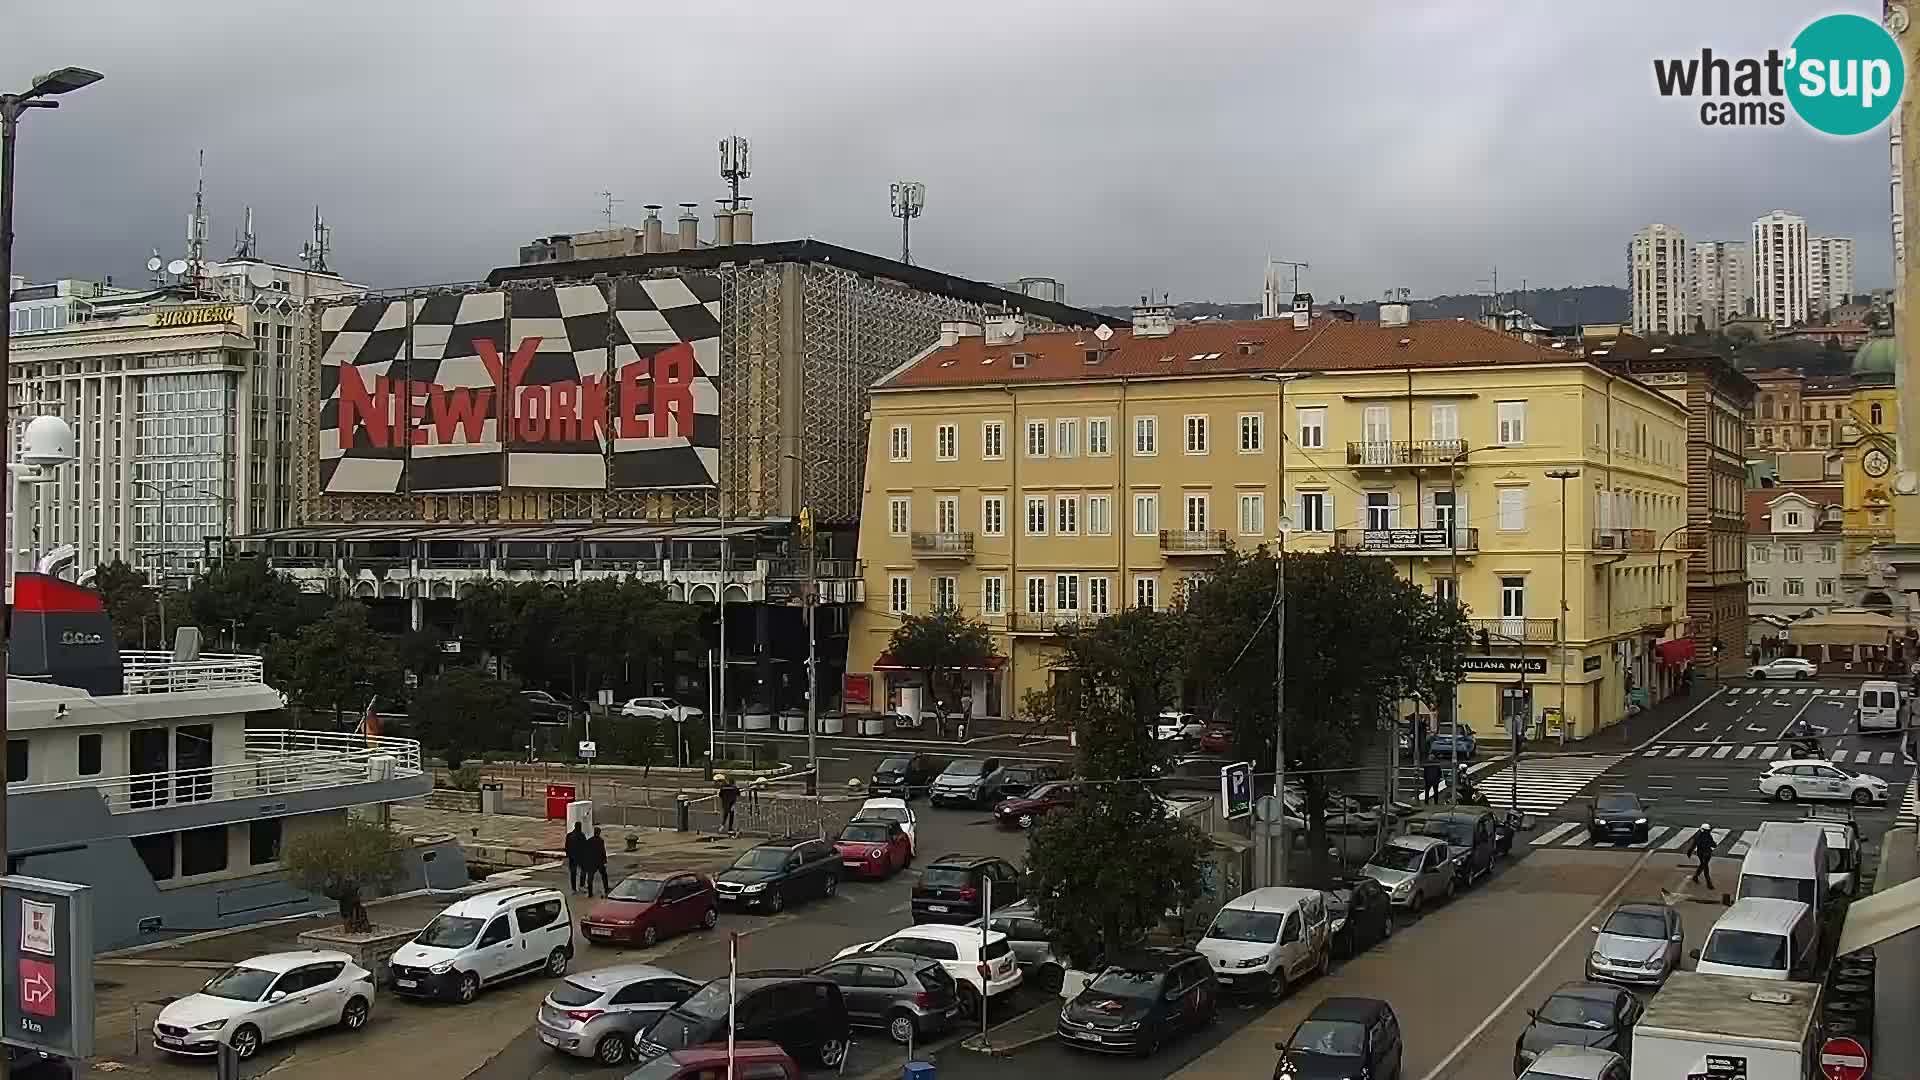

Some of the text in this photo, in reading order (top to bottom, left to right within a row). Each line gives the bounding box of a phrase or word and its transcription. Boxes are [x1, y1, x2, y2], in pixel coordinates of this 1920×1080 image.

[339, 359, 492, 449] NEW
[1460, 660, 1541, 671] JULIANA NAILS
[1232, 770, 1244, 794] P
[22, 1018, 42, 1033] 5 km
